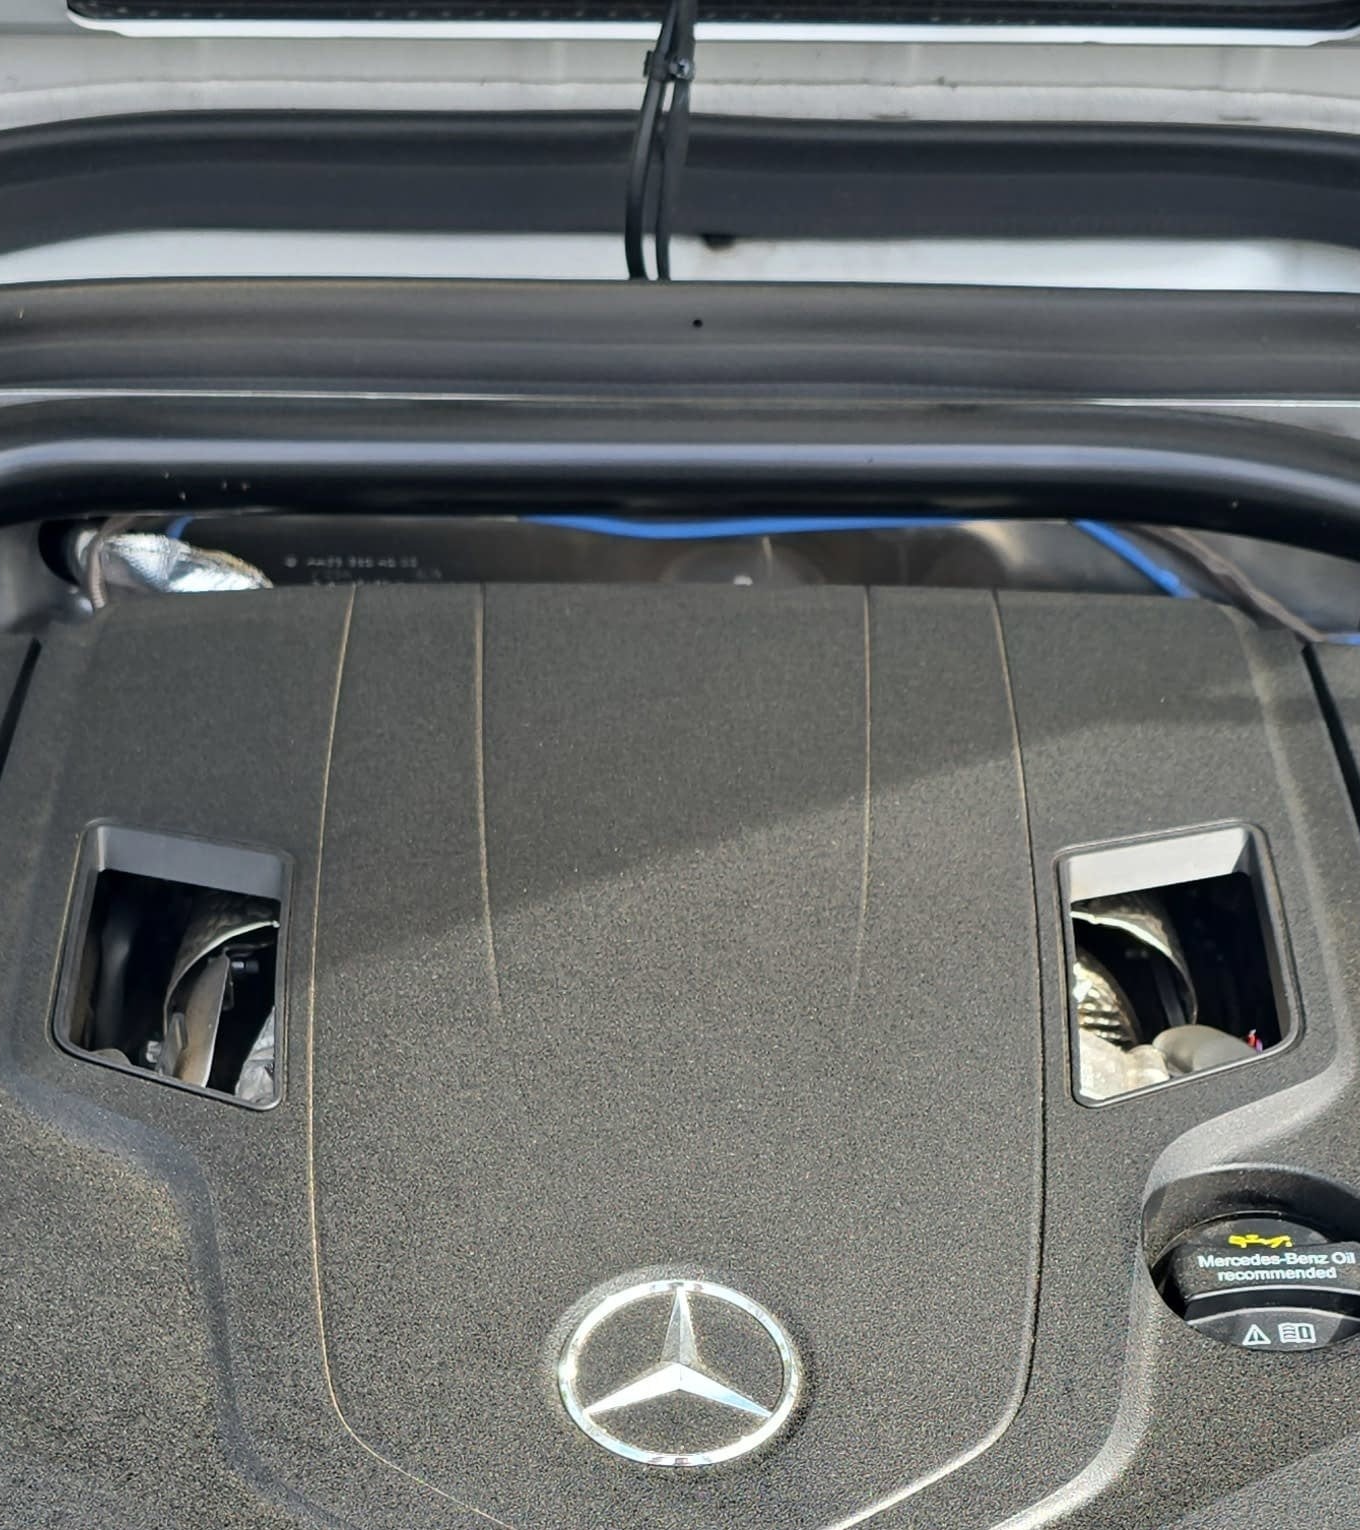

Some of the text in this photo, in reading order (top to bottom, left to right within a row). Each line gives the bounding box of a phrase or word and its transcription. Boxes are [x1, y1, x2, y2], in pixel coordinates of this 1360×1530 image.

[1197, 1251, 1356, 1268] Mercedes-Benz Oil
[1217, 1266, 1338, 1282] recommended
